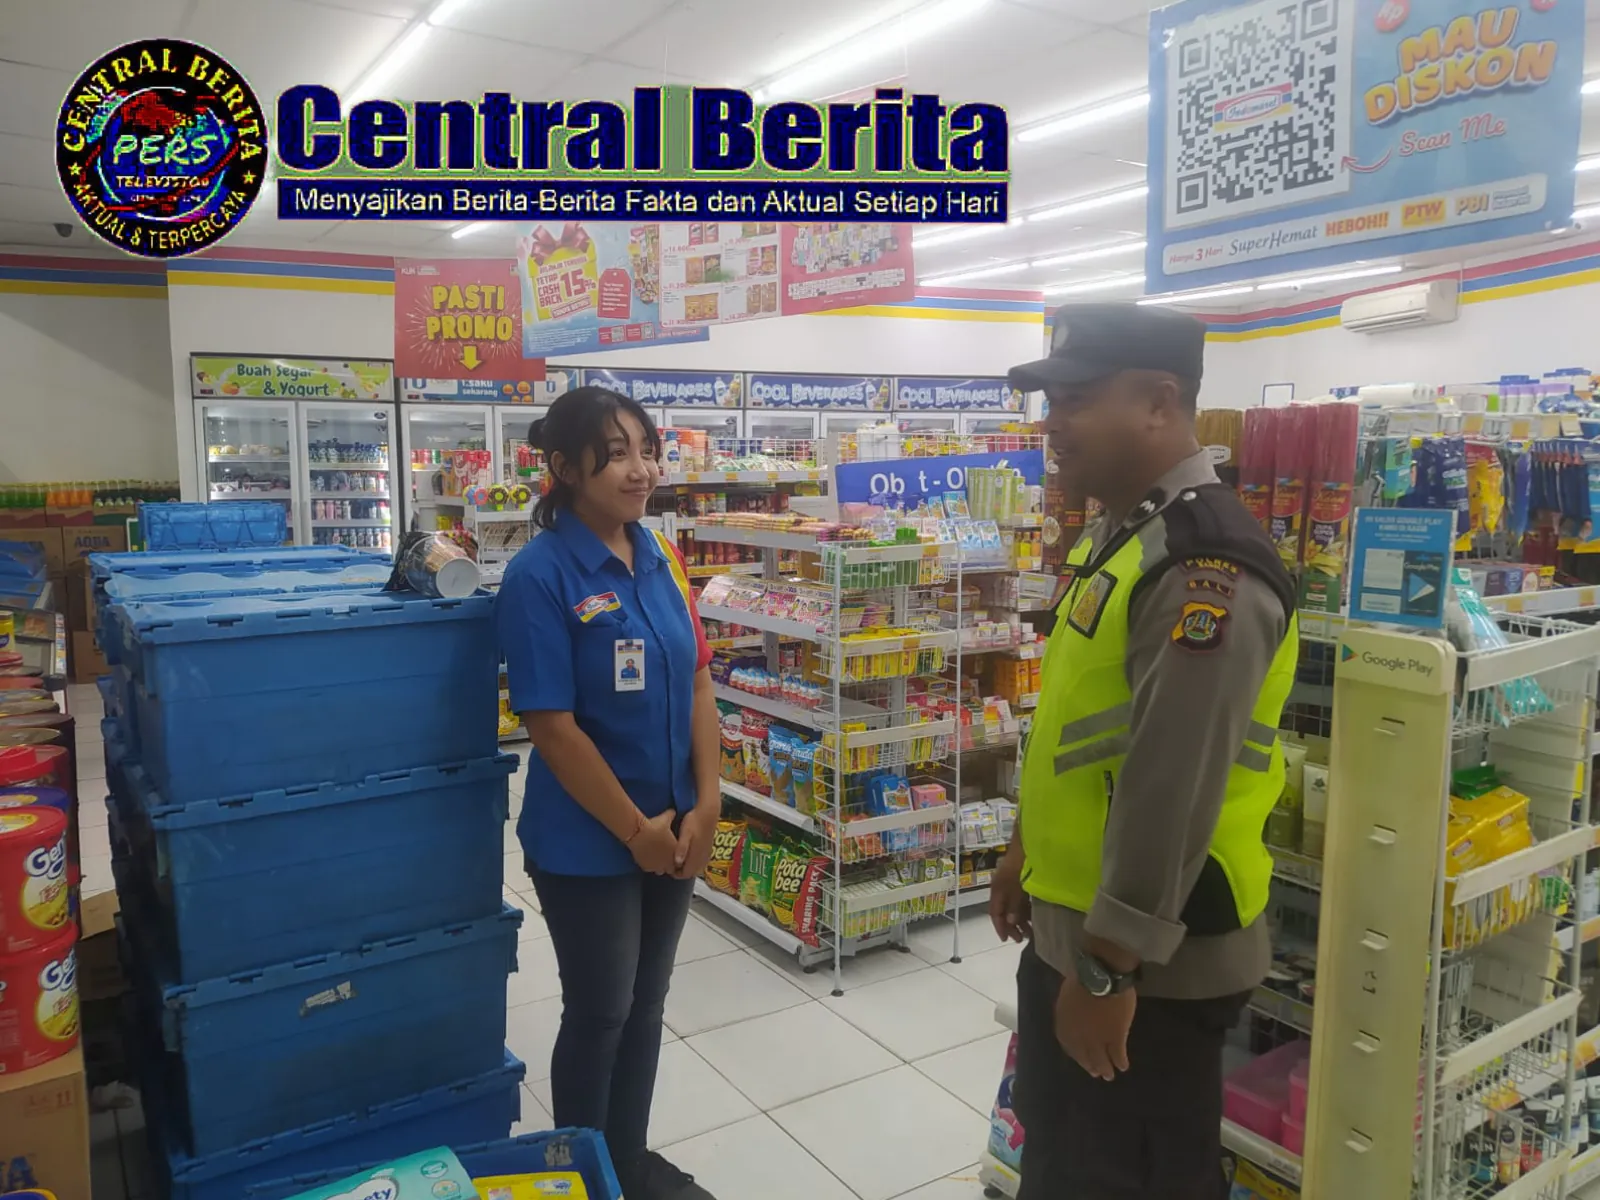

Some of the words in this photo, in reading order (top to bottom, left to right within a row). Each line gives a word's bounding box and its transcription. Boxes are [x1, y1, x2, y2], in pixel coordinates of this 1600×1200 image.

[1401, 8, 1519, 74] MAU
[1363, 40, 1558, 124] DISKON
[1399, 130, 1451, 156] Scan
[1460, 112, 1507, 141] Me
[1404, 201, 1444, 220] PTW
[1325, 212, 1390, 237] HEBOH!!
[1195, 248, 1204, 262] 3
[1204, 245, 1223, 258] Hari
[1229, 226, 1318, 256] SuperHemat
[538, 282, 561, 298] CASH
[560, 268, 596, 298] 15%
[431, 284, 505, 310] PASTI
[539, 293, 563, 308] BACK
[426, 314, 513, 341] PROMO
[236, 363, 272, 377] Buah
[263, 381, 276, 396] &
[280, 381, 330, 398] Yogurt
[632, 380, 713, 400] BEVERAGES
[752, 380, 790, 401] COOL
[791, 383, 864, 404] BEVERAGES
[900, 386, 934, 404] COOL
[935, 386, 1000, 406] BEVERAGES
[1424, 517, 1443, 526] PLAY
[1188, 579, 1232, 598] BALI
[1362, 650, 1406, 672] Google
[1408, 658, 1434, 678] Play
[776, 858, 808, 879] Pota
[775, 873, 802, 894] bee
[807, 870, 820, 893] PACK
[801, 895, 815, 934] SHARING
